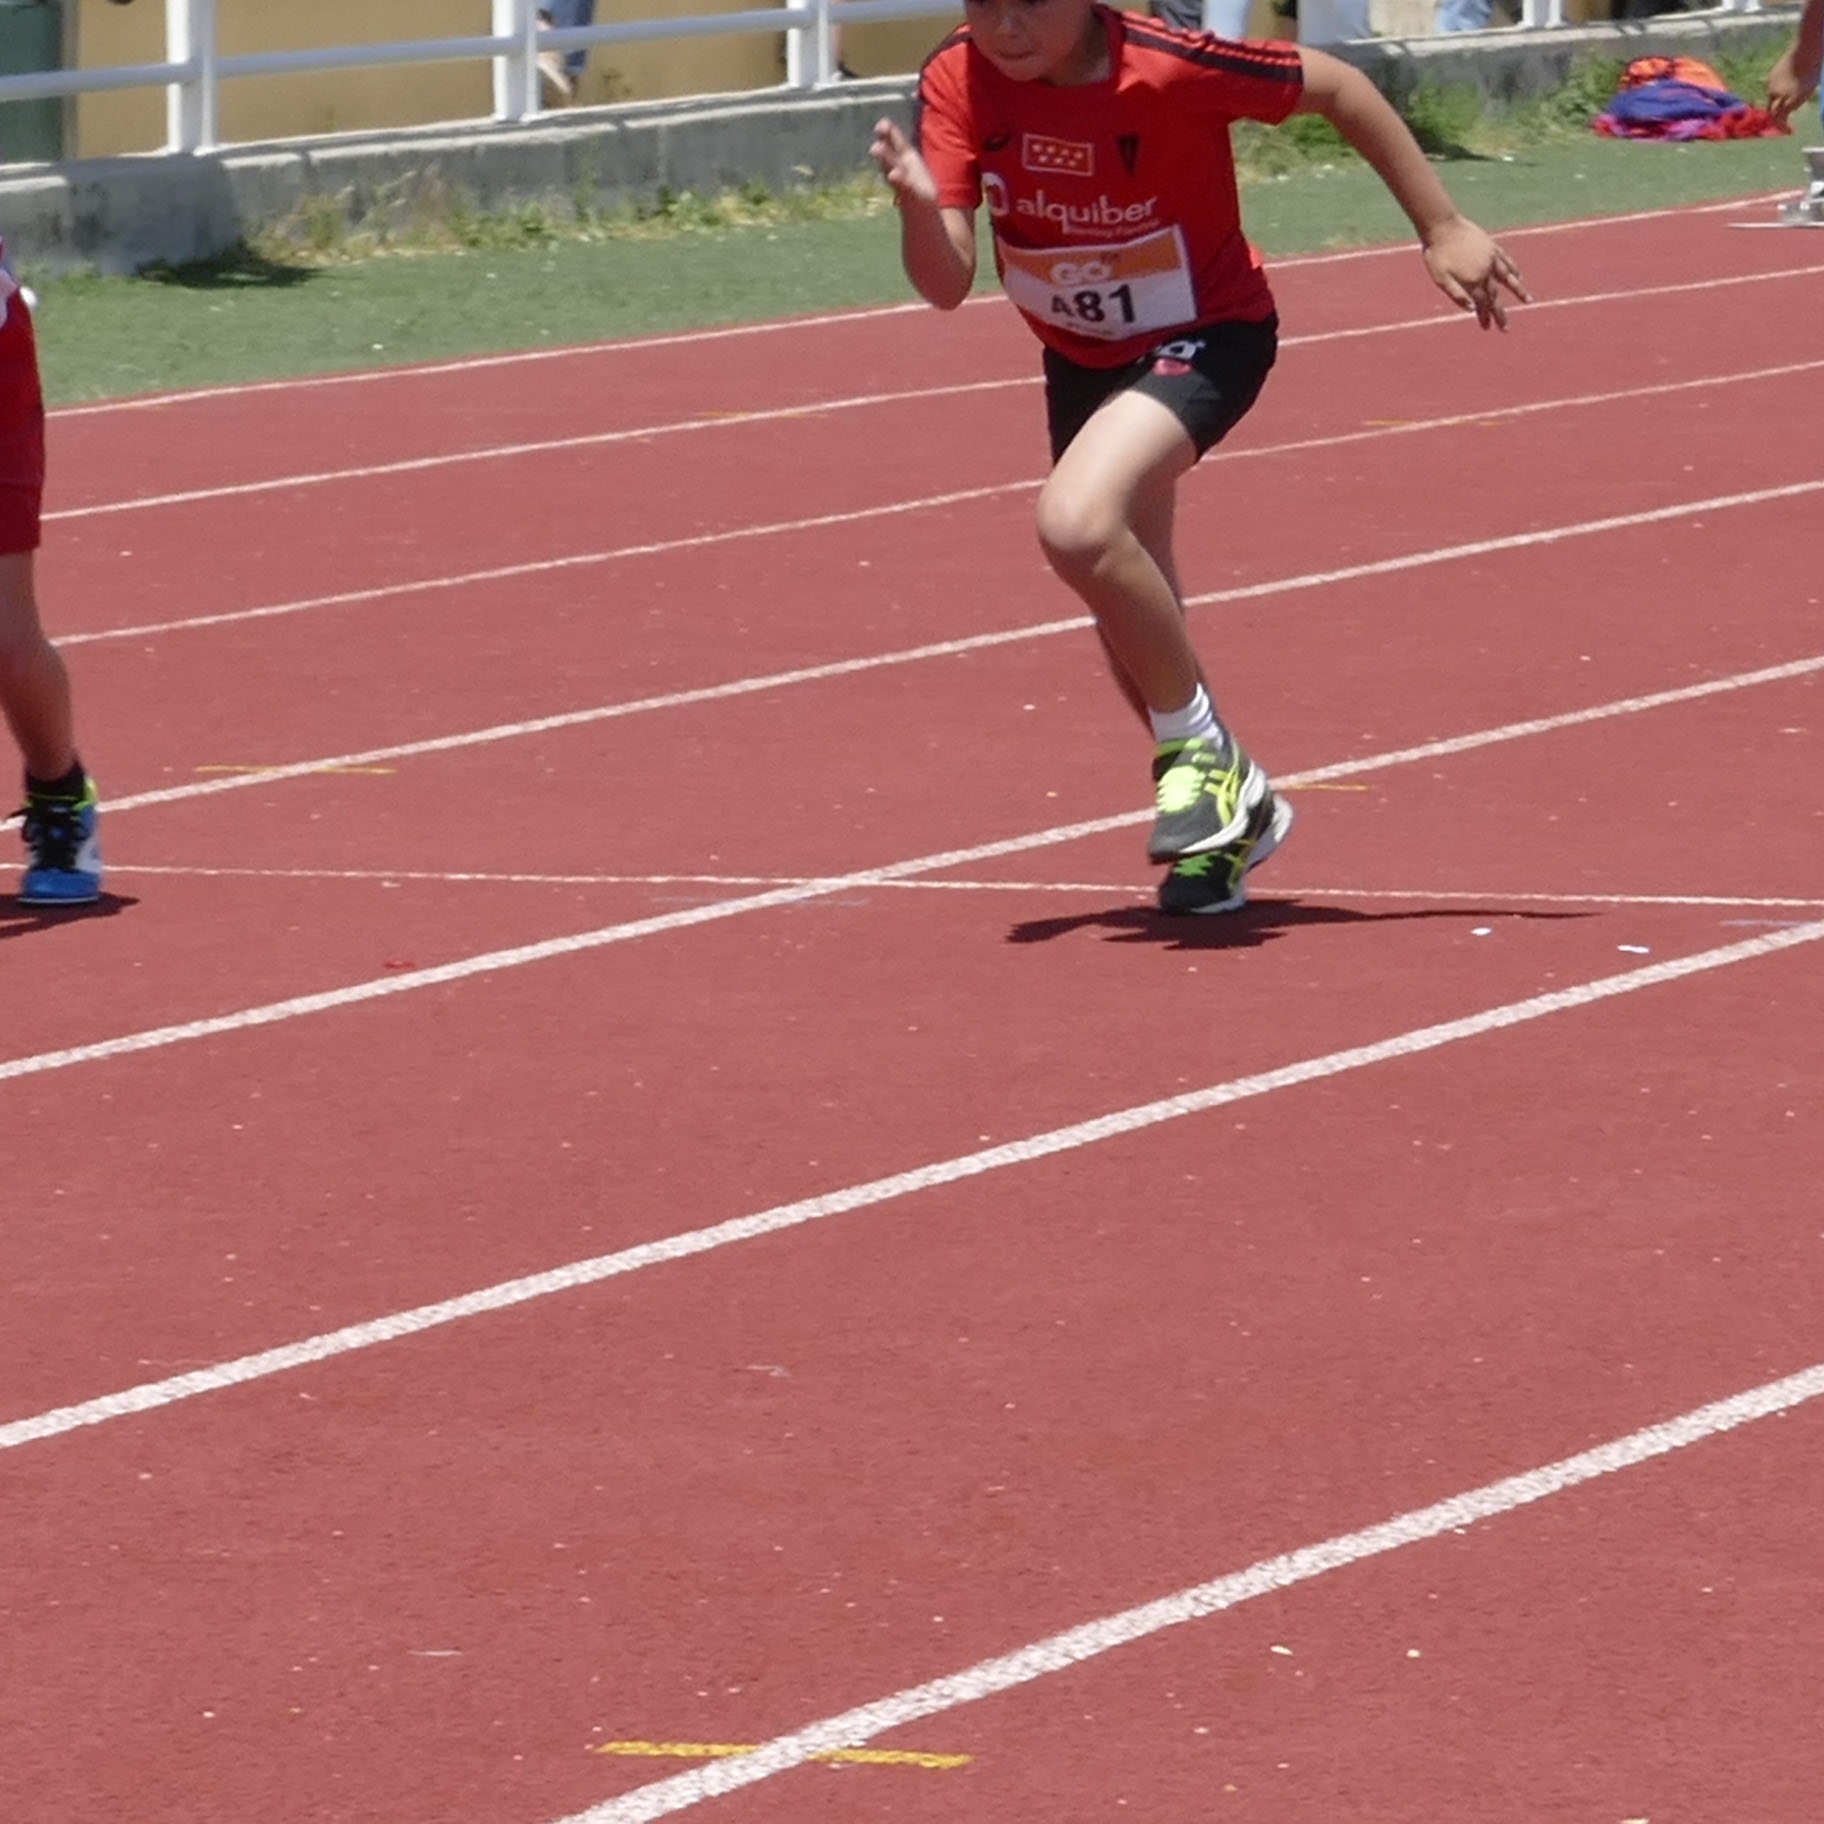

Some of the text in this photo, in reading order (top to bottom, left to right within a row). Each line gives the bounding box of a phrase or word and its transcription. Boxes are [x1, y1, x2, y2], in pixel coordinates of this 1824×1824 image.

[1016, 189, 1159, 234] alquiber
[1049, 261, 1114, 287] GO
[1051, 283, 1136, 325] A81
